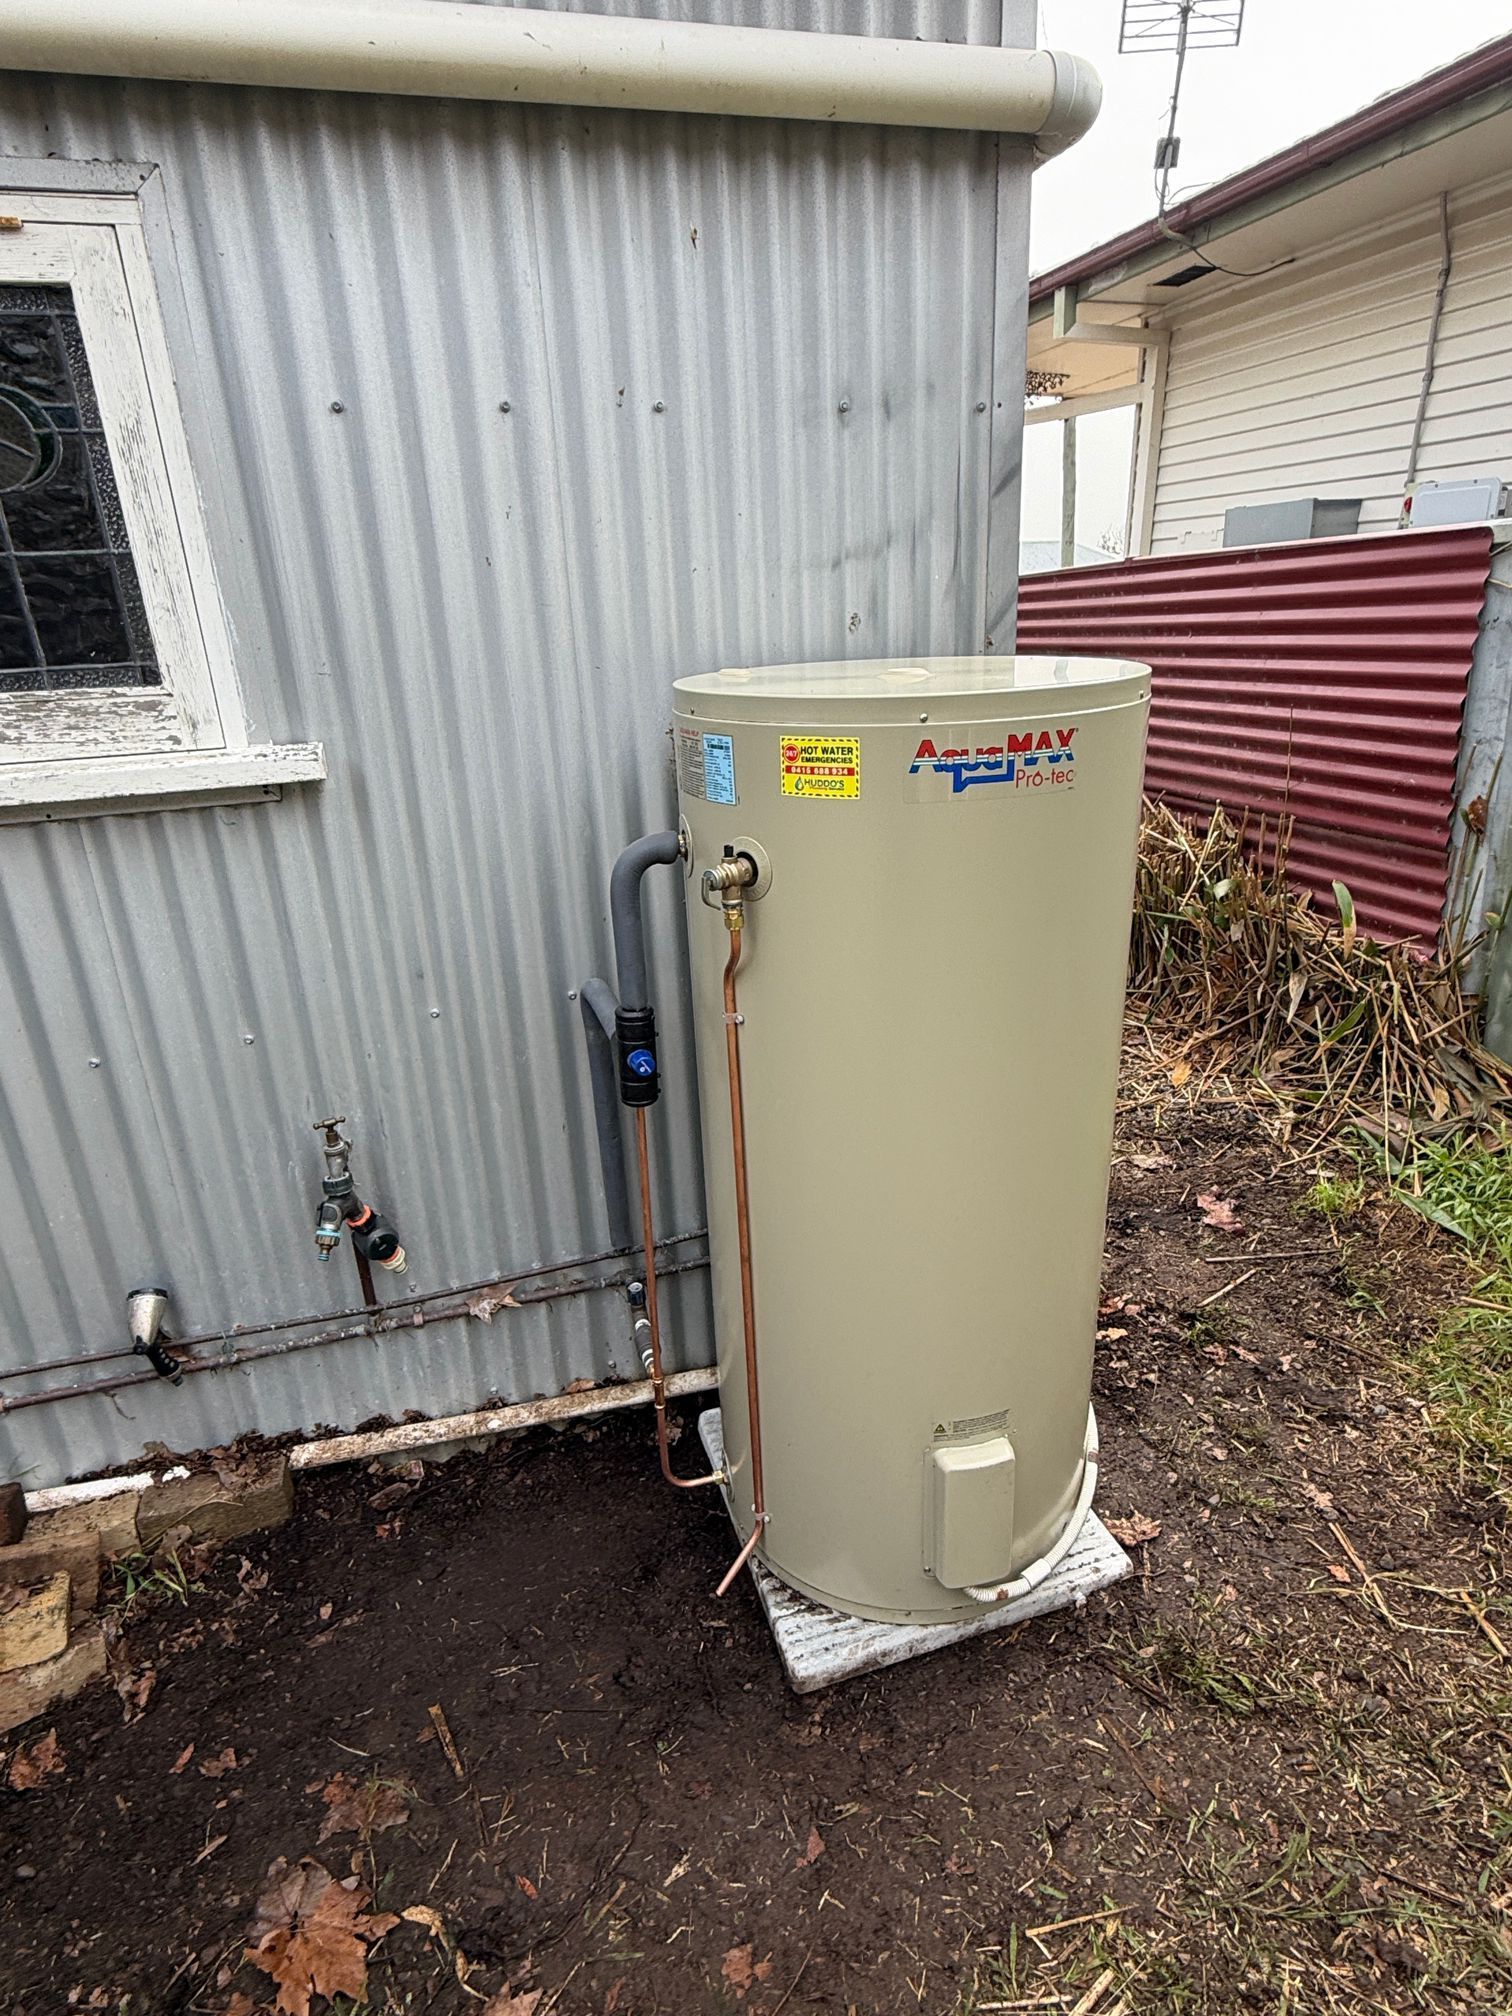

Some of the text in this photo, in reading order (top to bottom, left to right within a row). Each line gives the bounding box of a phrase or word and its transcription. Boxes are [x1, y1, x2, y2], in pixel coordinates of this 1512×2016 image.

[800, 746, 854, 756] HOT WATER
[801, 756, 853, 764] EMERGENCIES
[909, 728, 1075, 793] AquaMAX
[804, 779, 845, 788] HUDDO'S
[1016, 768, 1075, 789] Pro-tec
